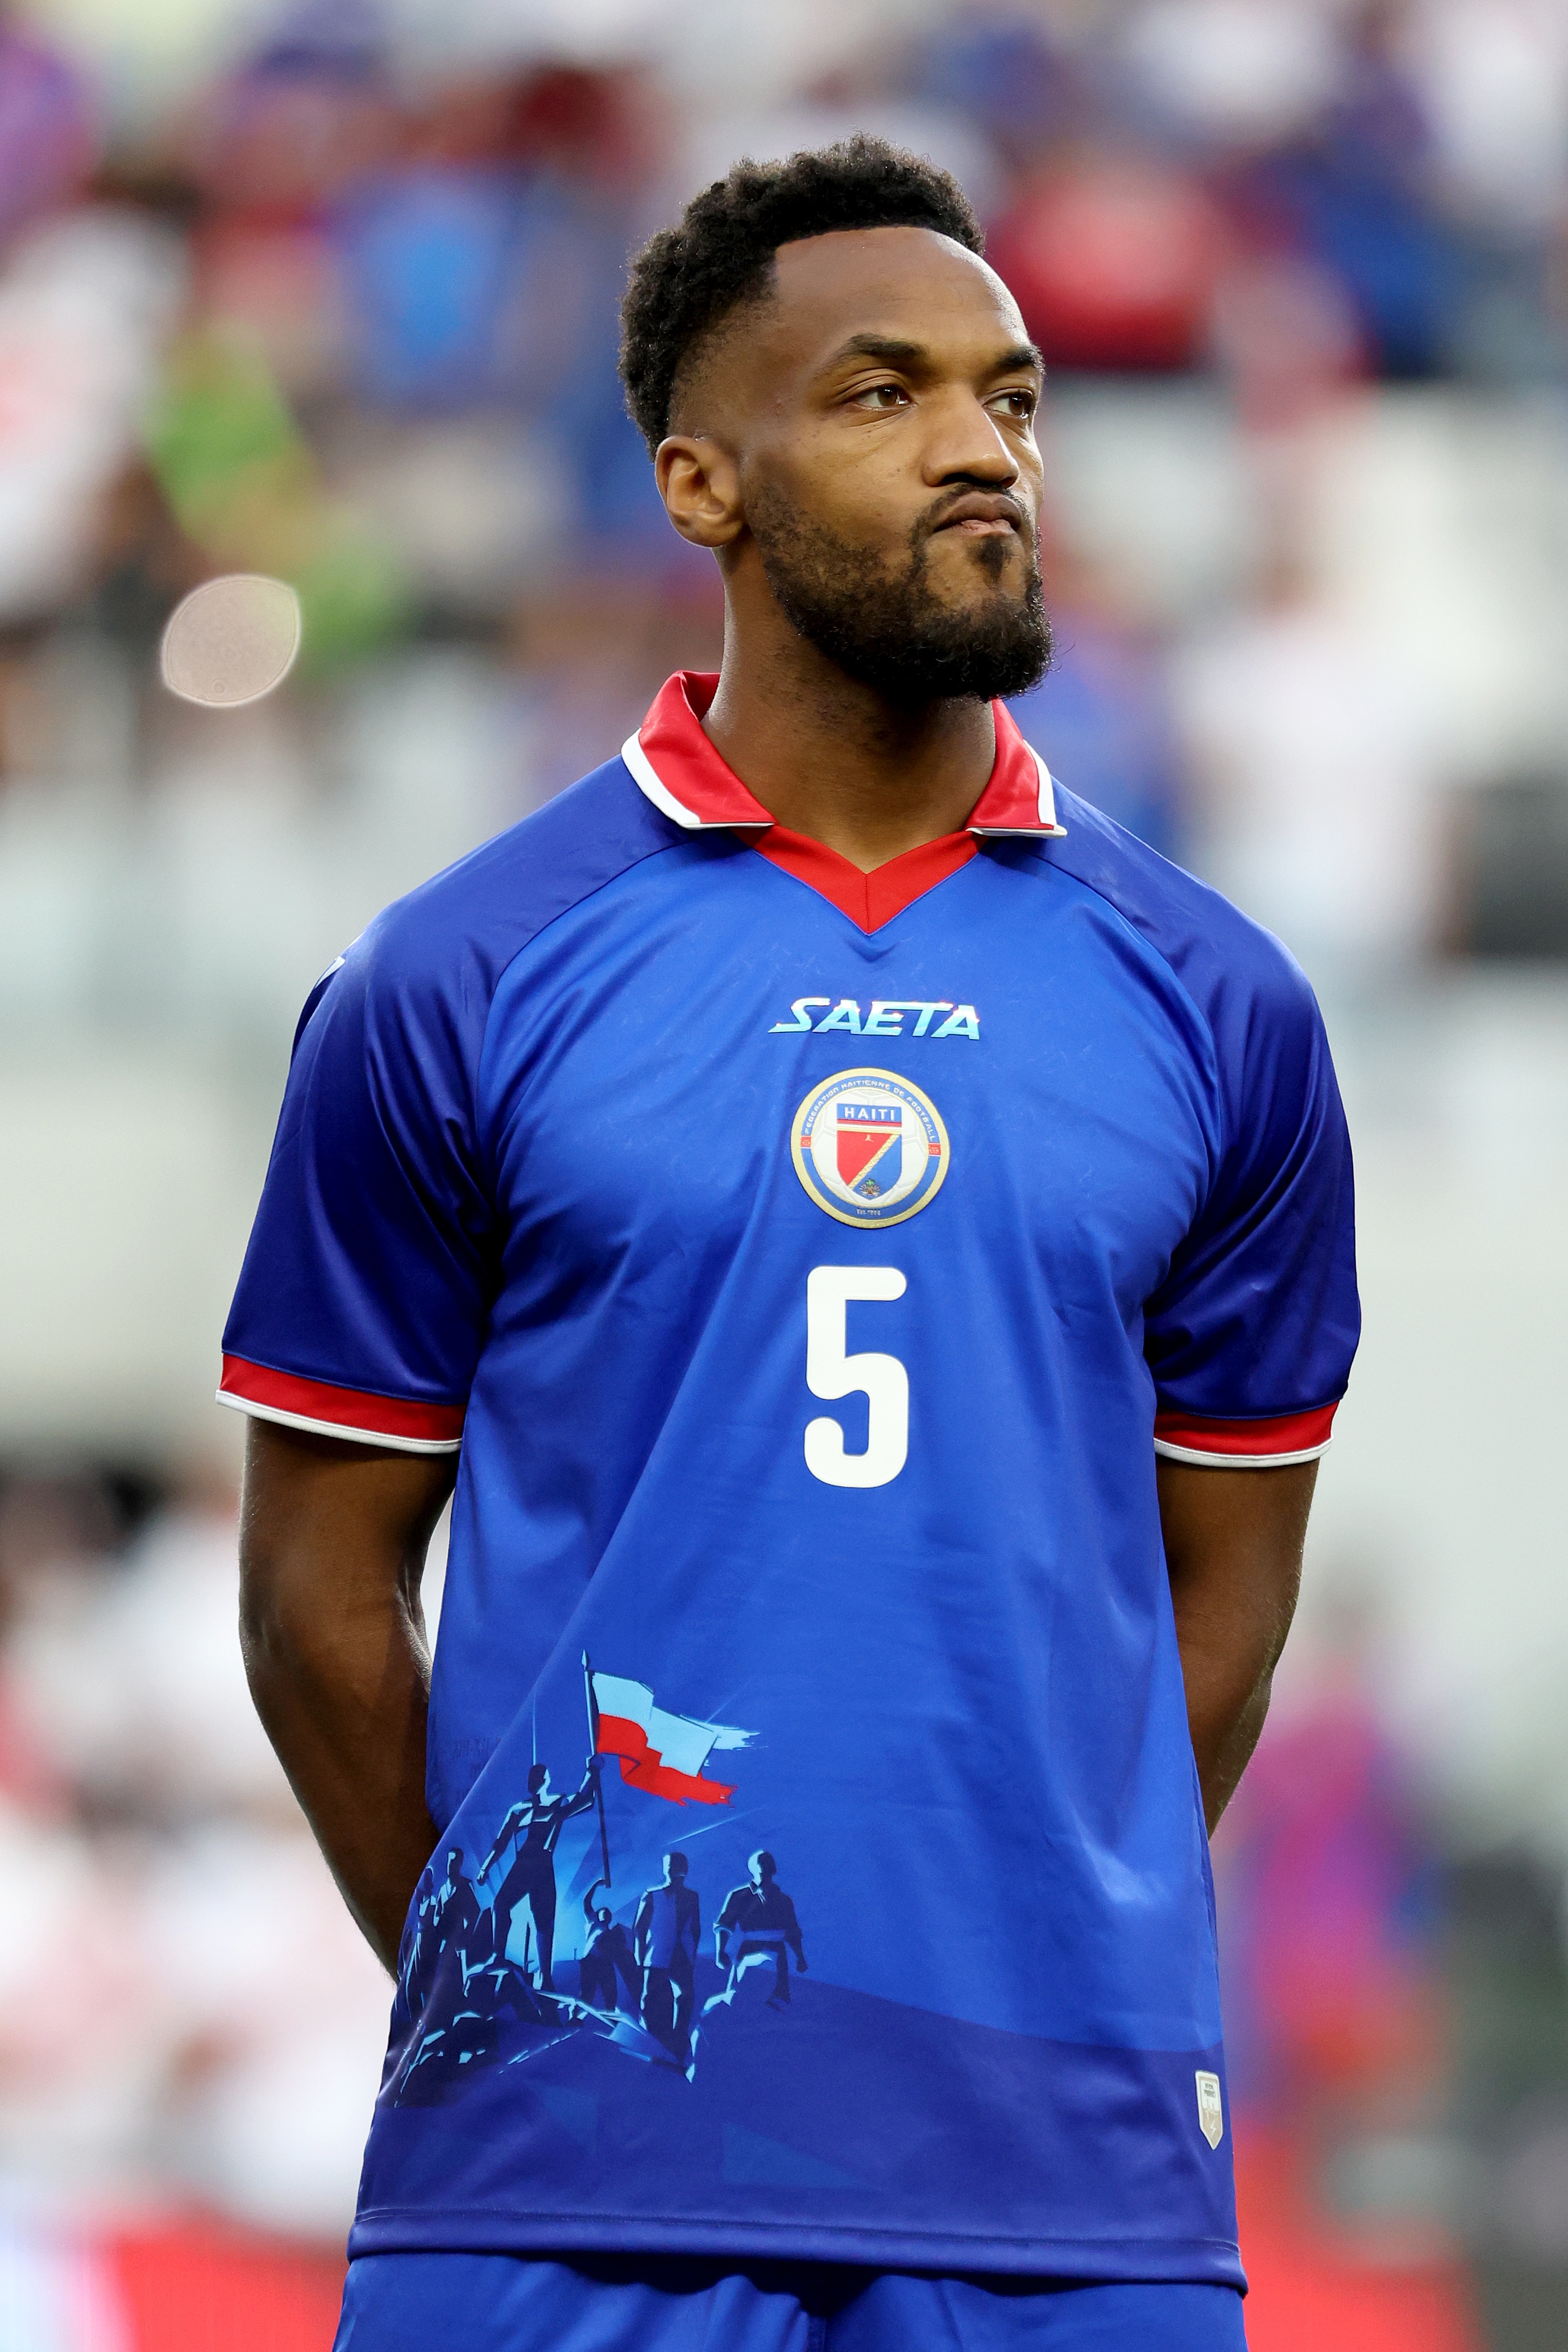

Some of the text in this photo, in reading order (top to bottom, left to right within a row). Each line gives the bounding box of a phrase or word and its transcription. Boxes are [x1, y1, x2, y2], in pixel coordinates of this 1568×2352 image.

[768, 997, 980, 1040] SAETA
[844, 1106, 895, 1121] HAITI
[893, 1086, 906, 1097] DE
[906, 1096, 936, 1141] FOOTBALL
[804, 1266, 909, 1488] 5
